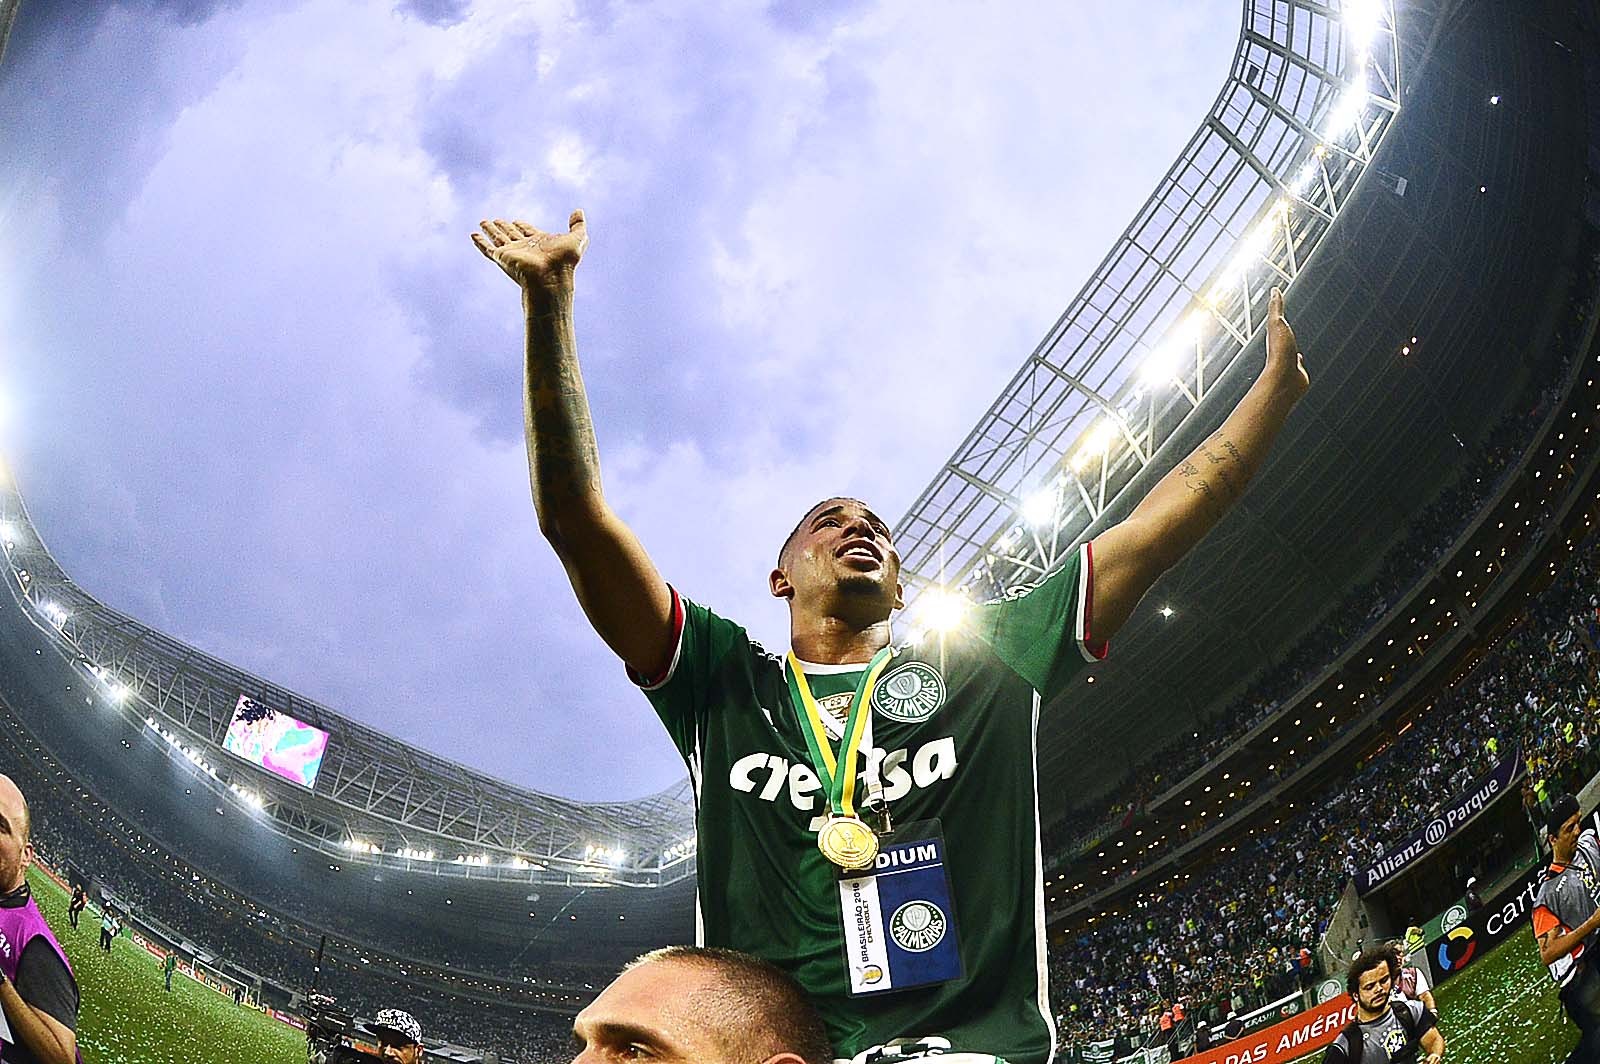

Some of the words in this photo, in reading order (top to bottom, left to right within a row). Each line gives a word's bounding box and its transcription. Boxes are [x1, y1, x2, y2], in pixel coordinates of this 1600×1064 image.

[880, 680, 939, 716] PALMEIRAS
[730, 737, 960, 820] cresa
[1366, 838, 1424, 887] Allianz
[1446, 778, 1499, 828] Parque
[843, 844, 938, 874] DIUM
[852, 882, 862, 903] 2016
[1487, 865, 1548, 935] cart
[855, 905, 869, 962] BRASILEIRÃO
[863, 900, 873, 943] CHEVROLET
[893, 920, 943, 949] PALMEIRAS
[1275, 1003, 1357, 1054] AMÉRIC
